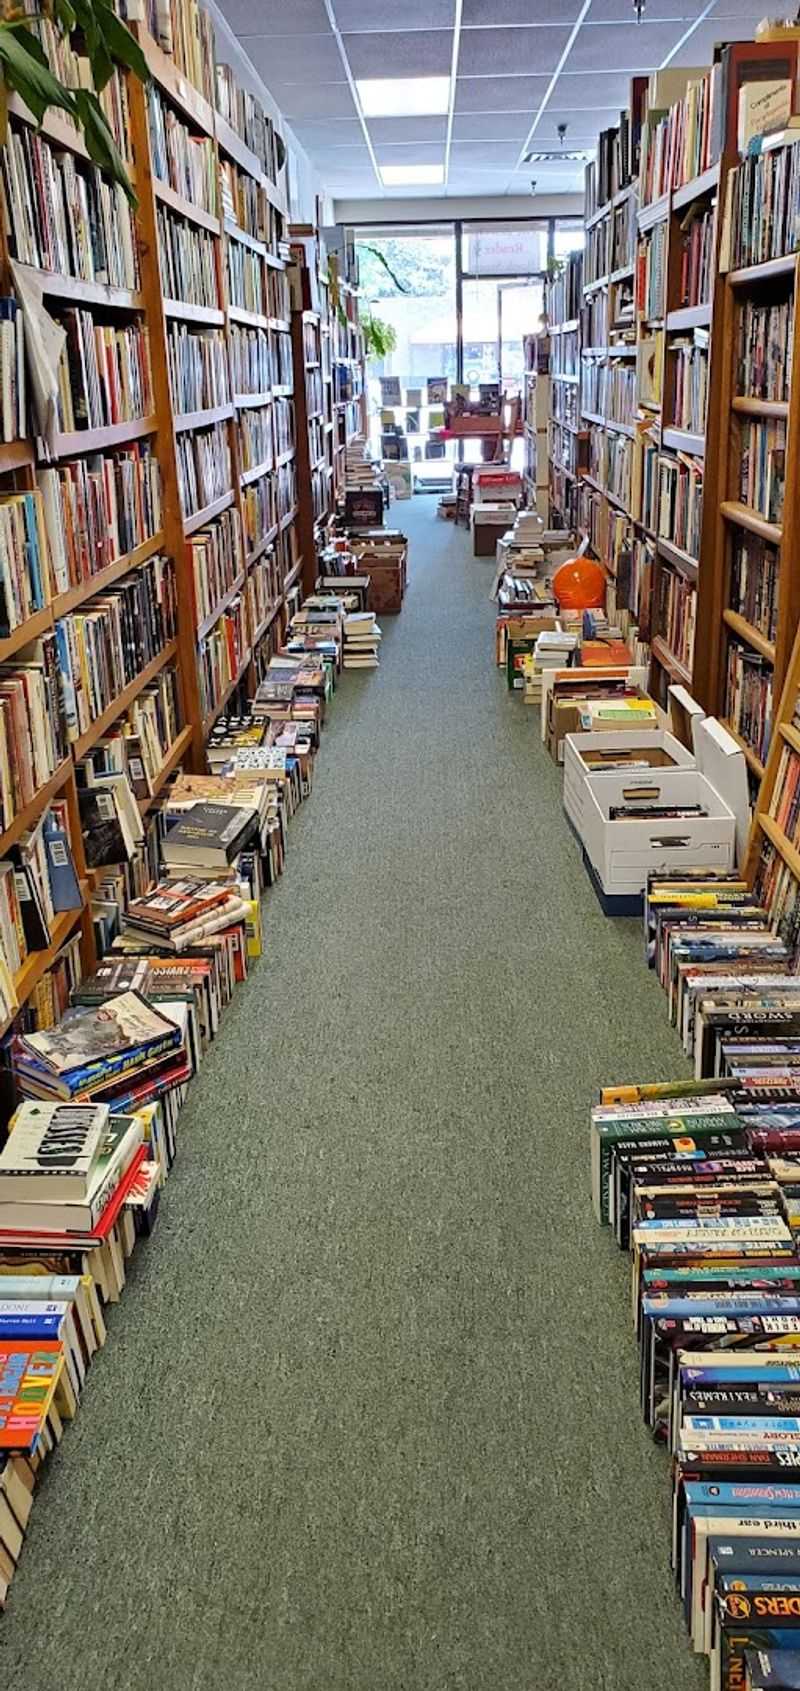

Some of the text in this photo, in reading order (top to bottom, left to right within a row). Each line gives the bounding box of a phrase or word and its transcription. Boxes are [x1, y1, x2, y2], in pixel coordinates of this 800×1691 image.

[7, 1352, 59, 1431] HOOVER
[689, 1391, 749, 1401] EXTREMES
[764, 1520, 797, 1531] third
[747, 1548, 794, 1556] SPENCER
